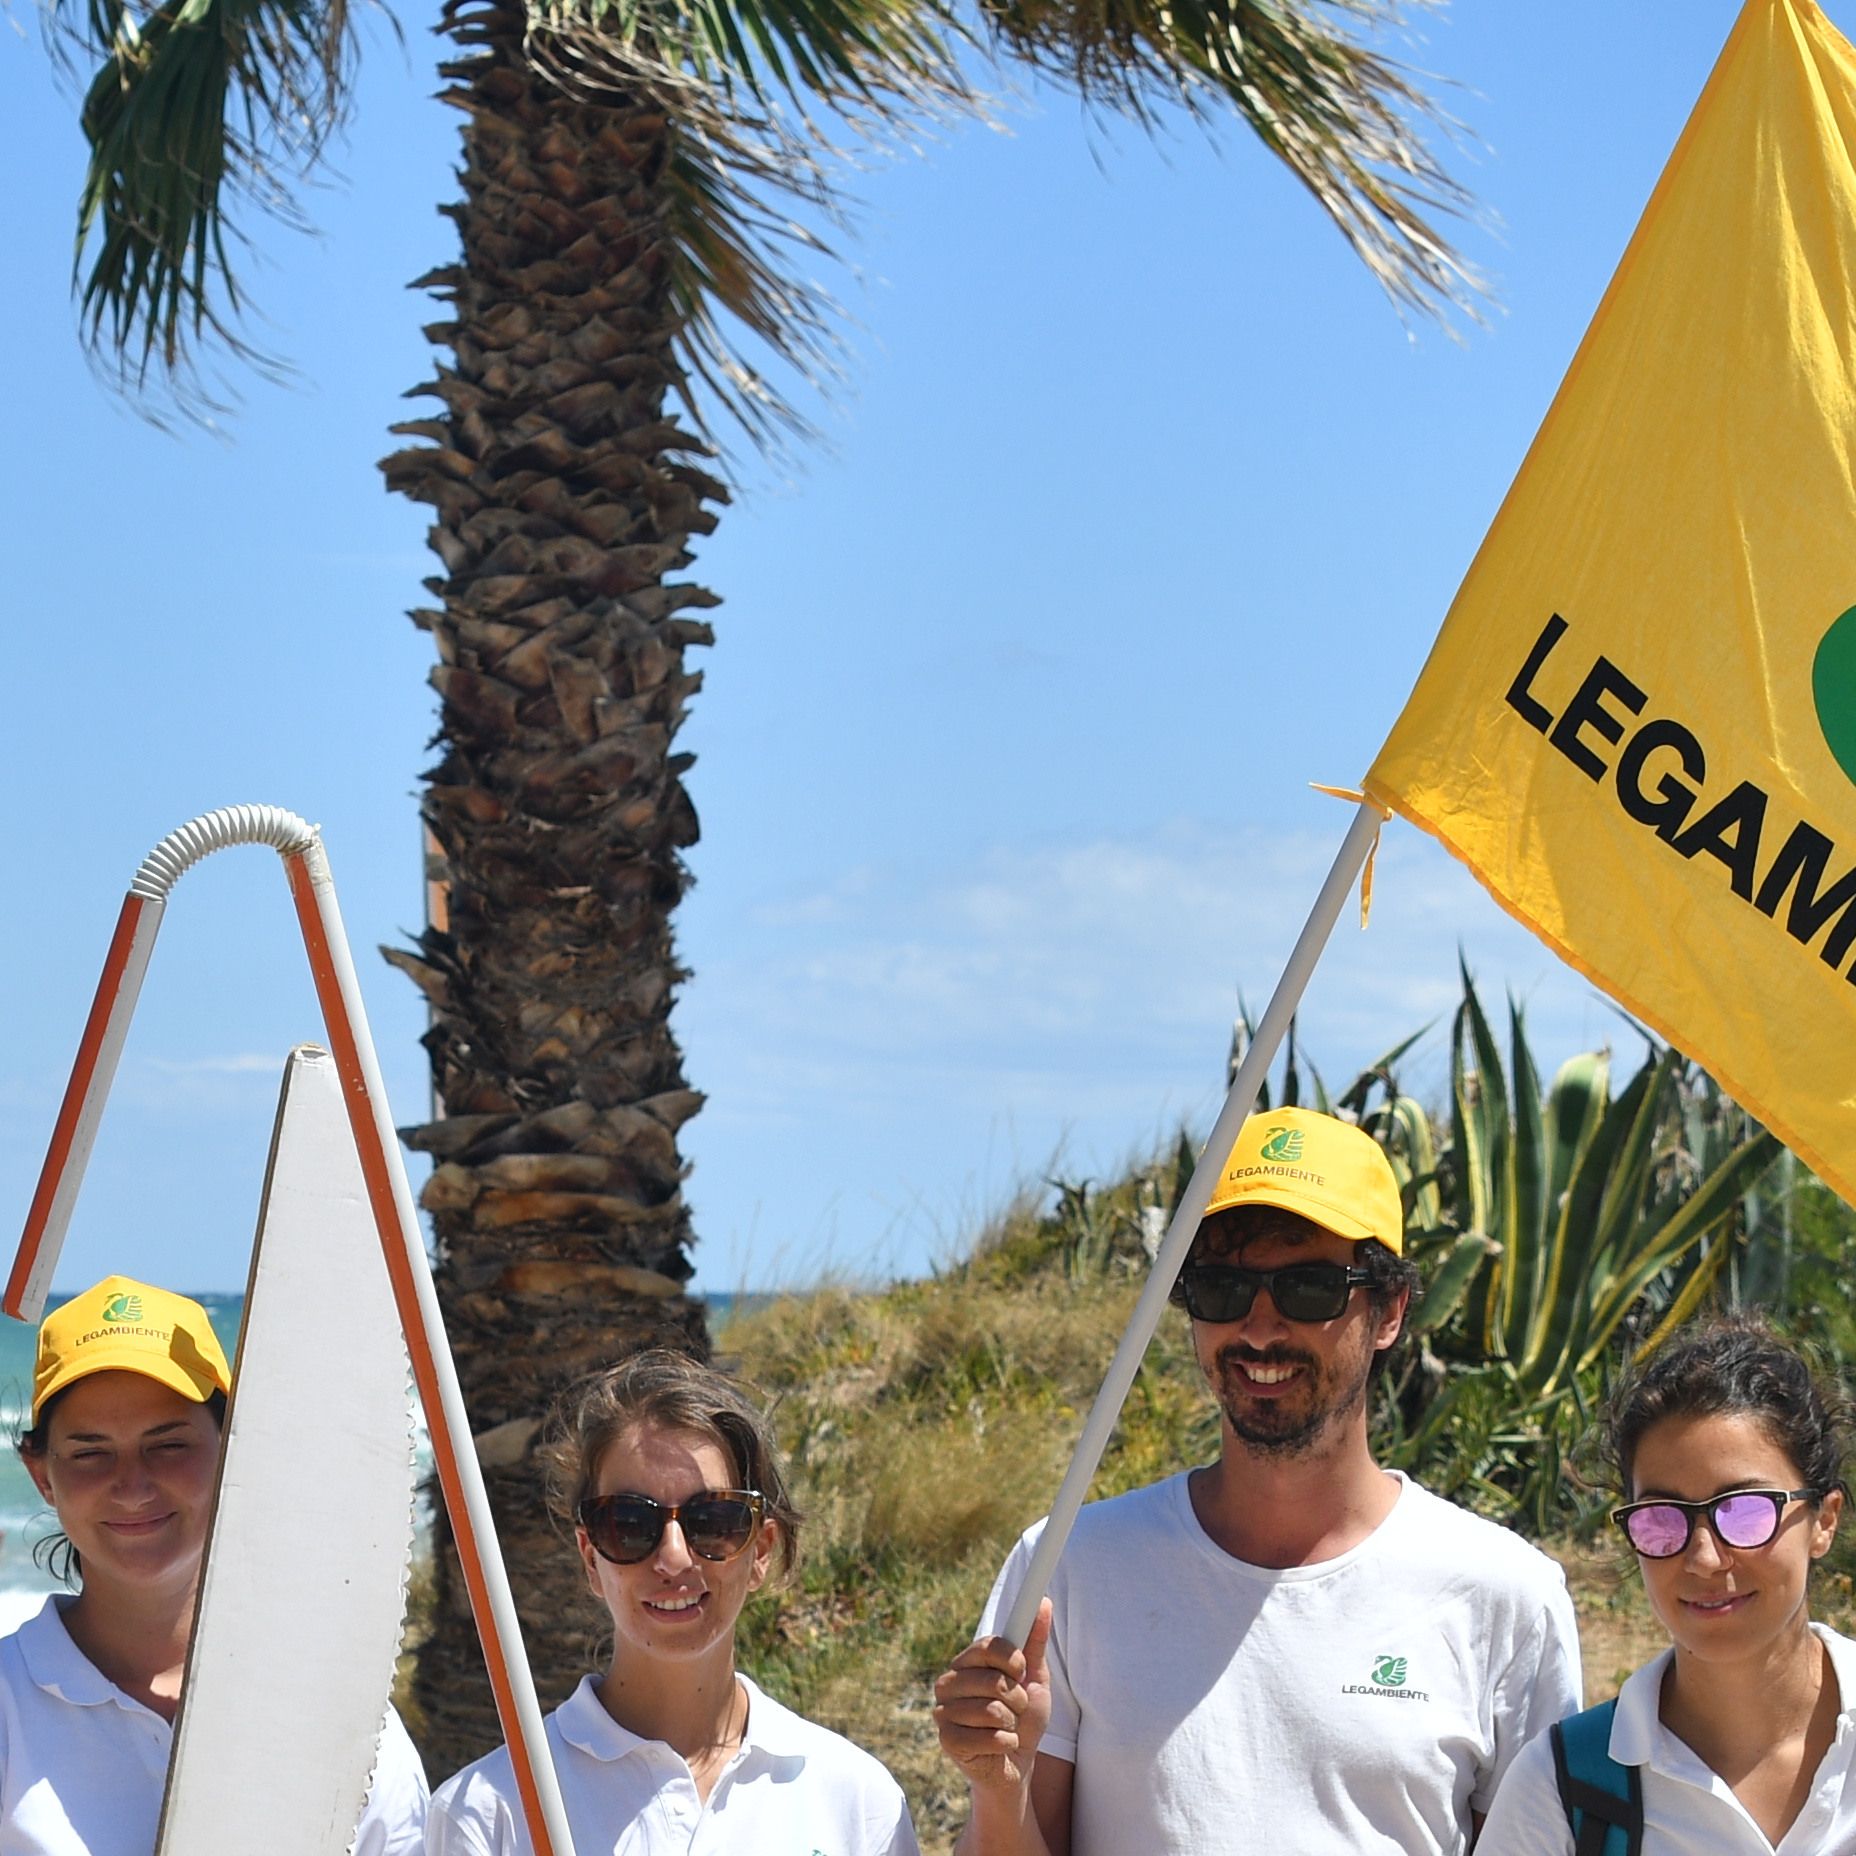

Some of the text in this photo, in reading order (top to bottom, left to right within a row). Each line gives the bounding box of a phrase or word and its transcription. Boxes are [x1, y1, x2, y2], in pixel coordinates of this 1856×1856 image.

[1229, 1165, 1326, 1187] LEGAMBIENTE
[75, 1325, 171, 1347] LEGAMBIENTE
[1341, 1684, 1430, 1702] LEGAMBIENTE
